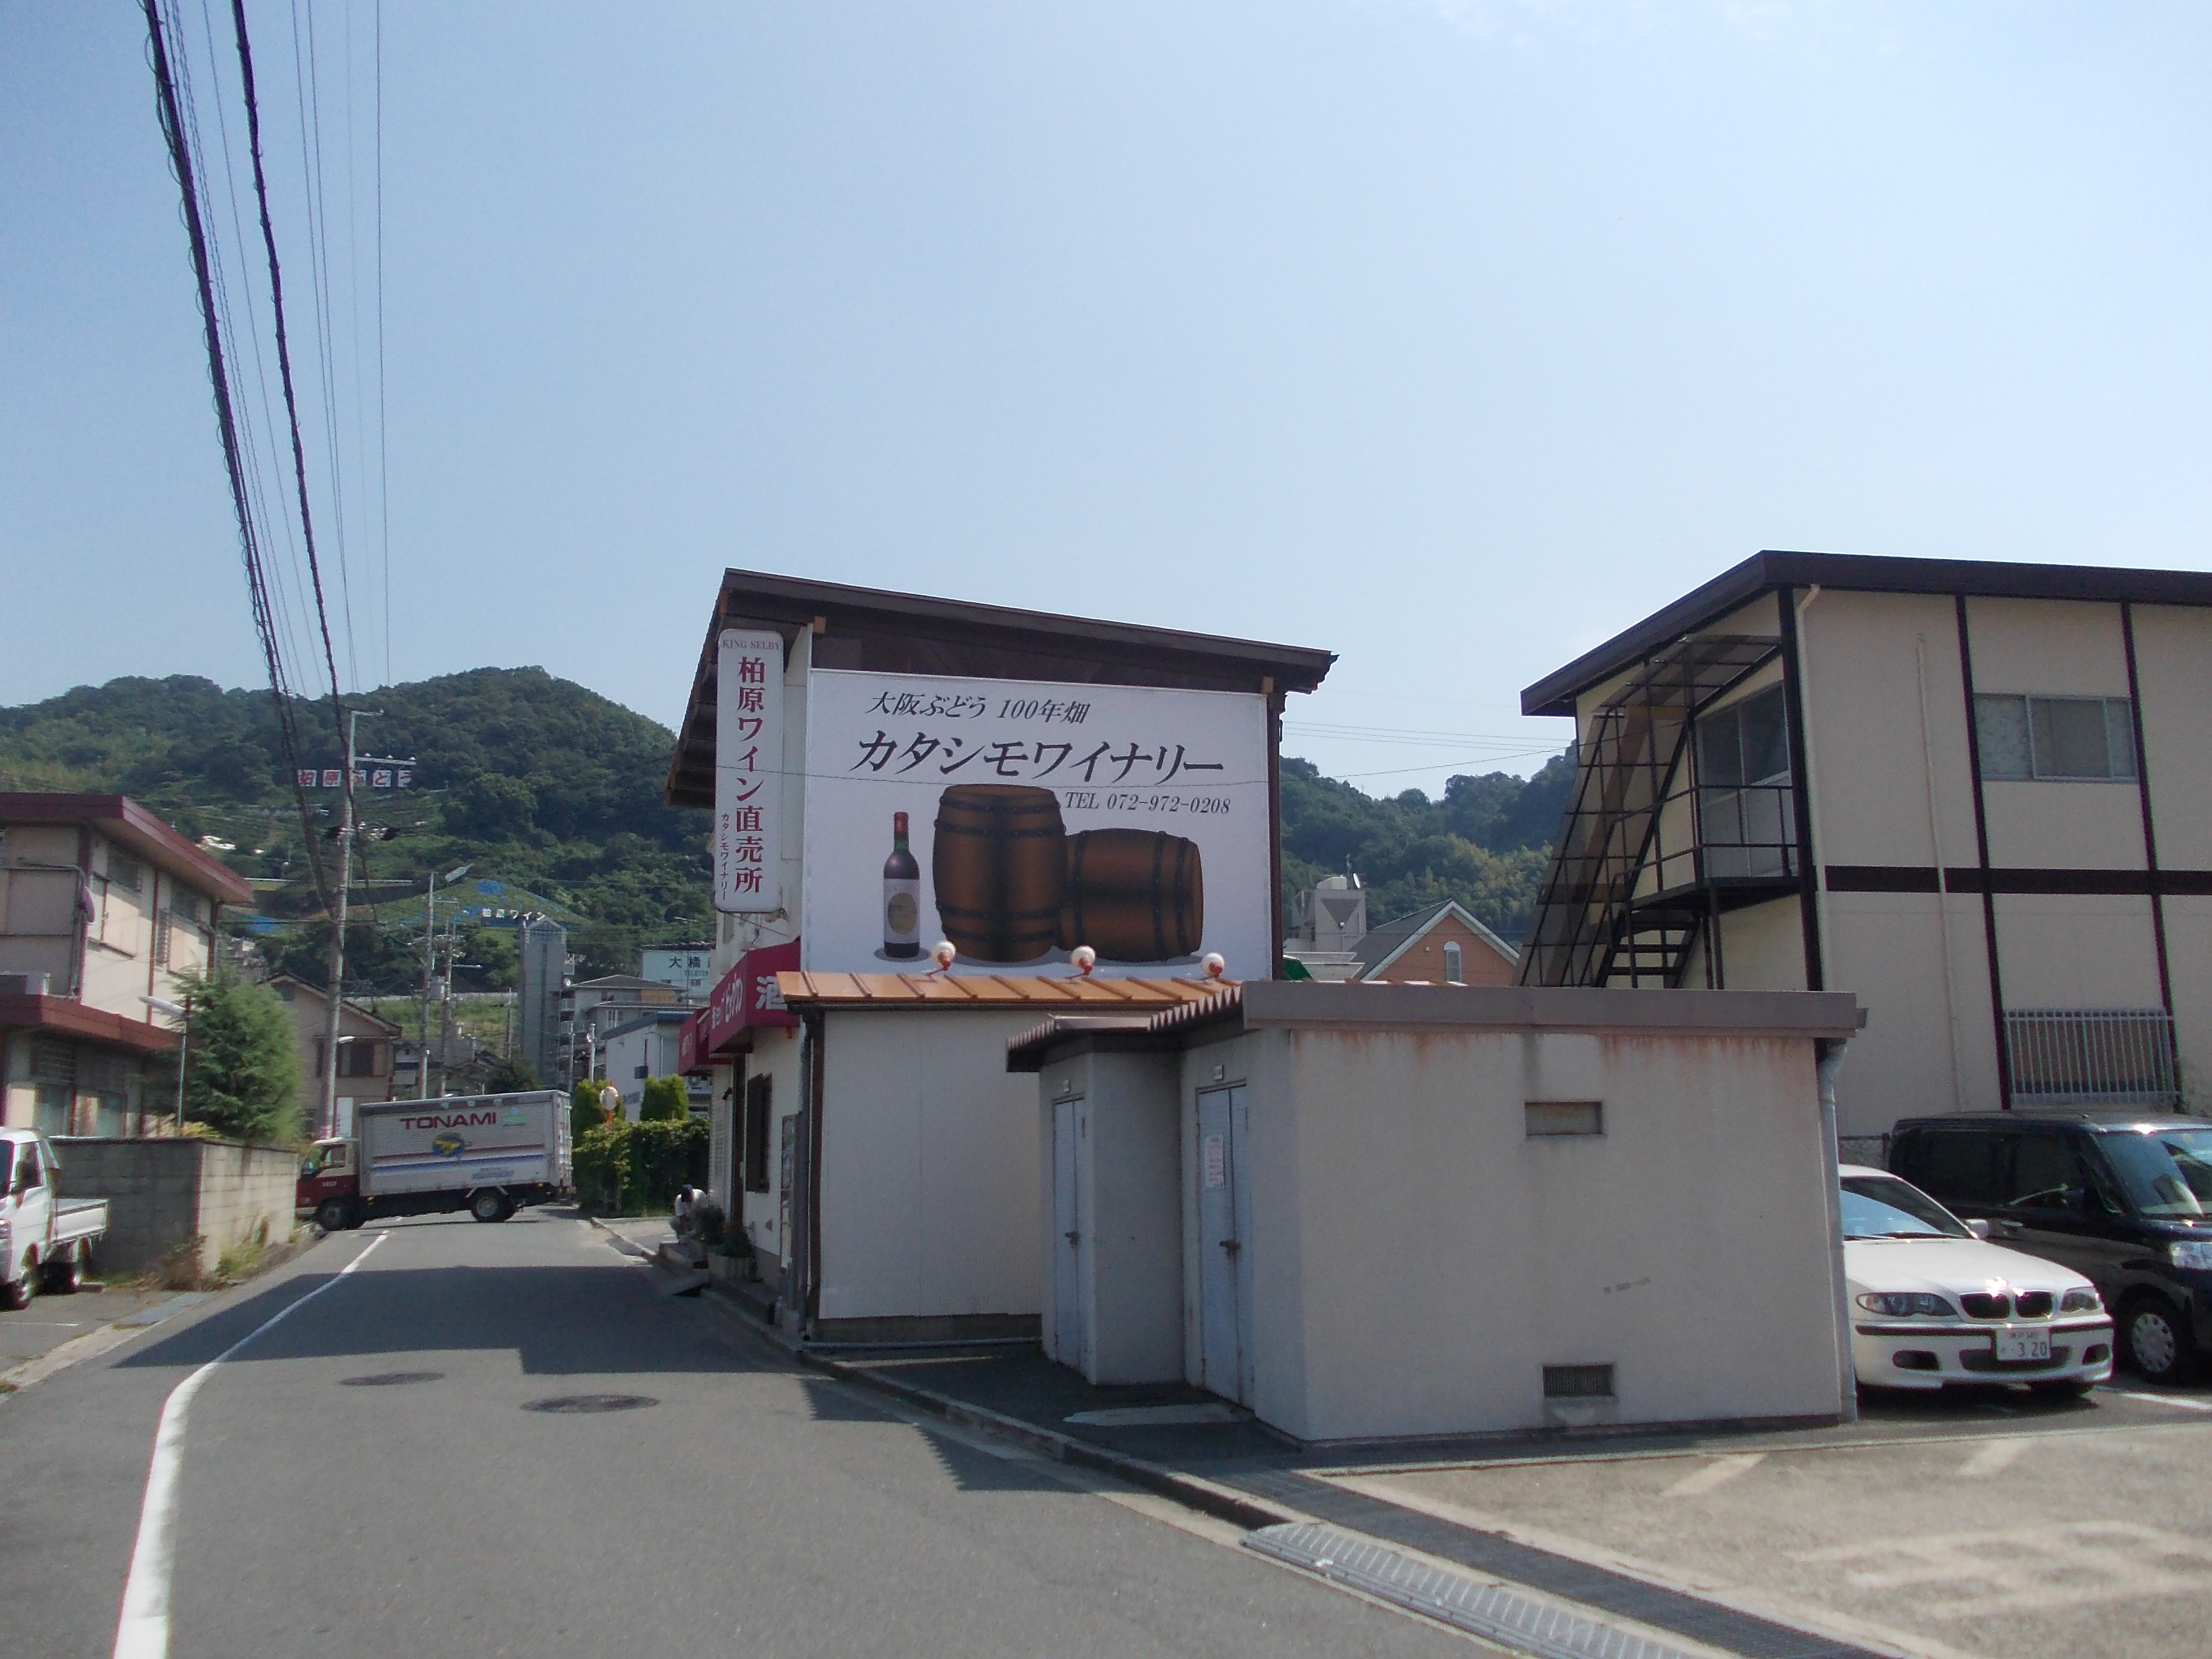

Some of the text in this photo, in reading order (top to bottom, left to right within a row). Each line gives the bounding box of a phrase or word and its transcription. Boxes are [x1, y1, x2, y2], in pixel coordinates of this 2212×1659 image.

[722, 639, 780, 651] KING SELBY
[865, 691, 1091, 725] 大阪ぶどう 100年畑
[848, 729, 1224, 785] カタシモワイナリー
[734, 656, 766, 894] 柏原ワイン直売所
[1065, 792, 1232, 814] TEL 072-972-0208
[720, 813, 730, 900] カタシモワイナリー
[669, 956, 711, 969] 大橋
[400, 1111, 497, 1130] TONAMI
